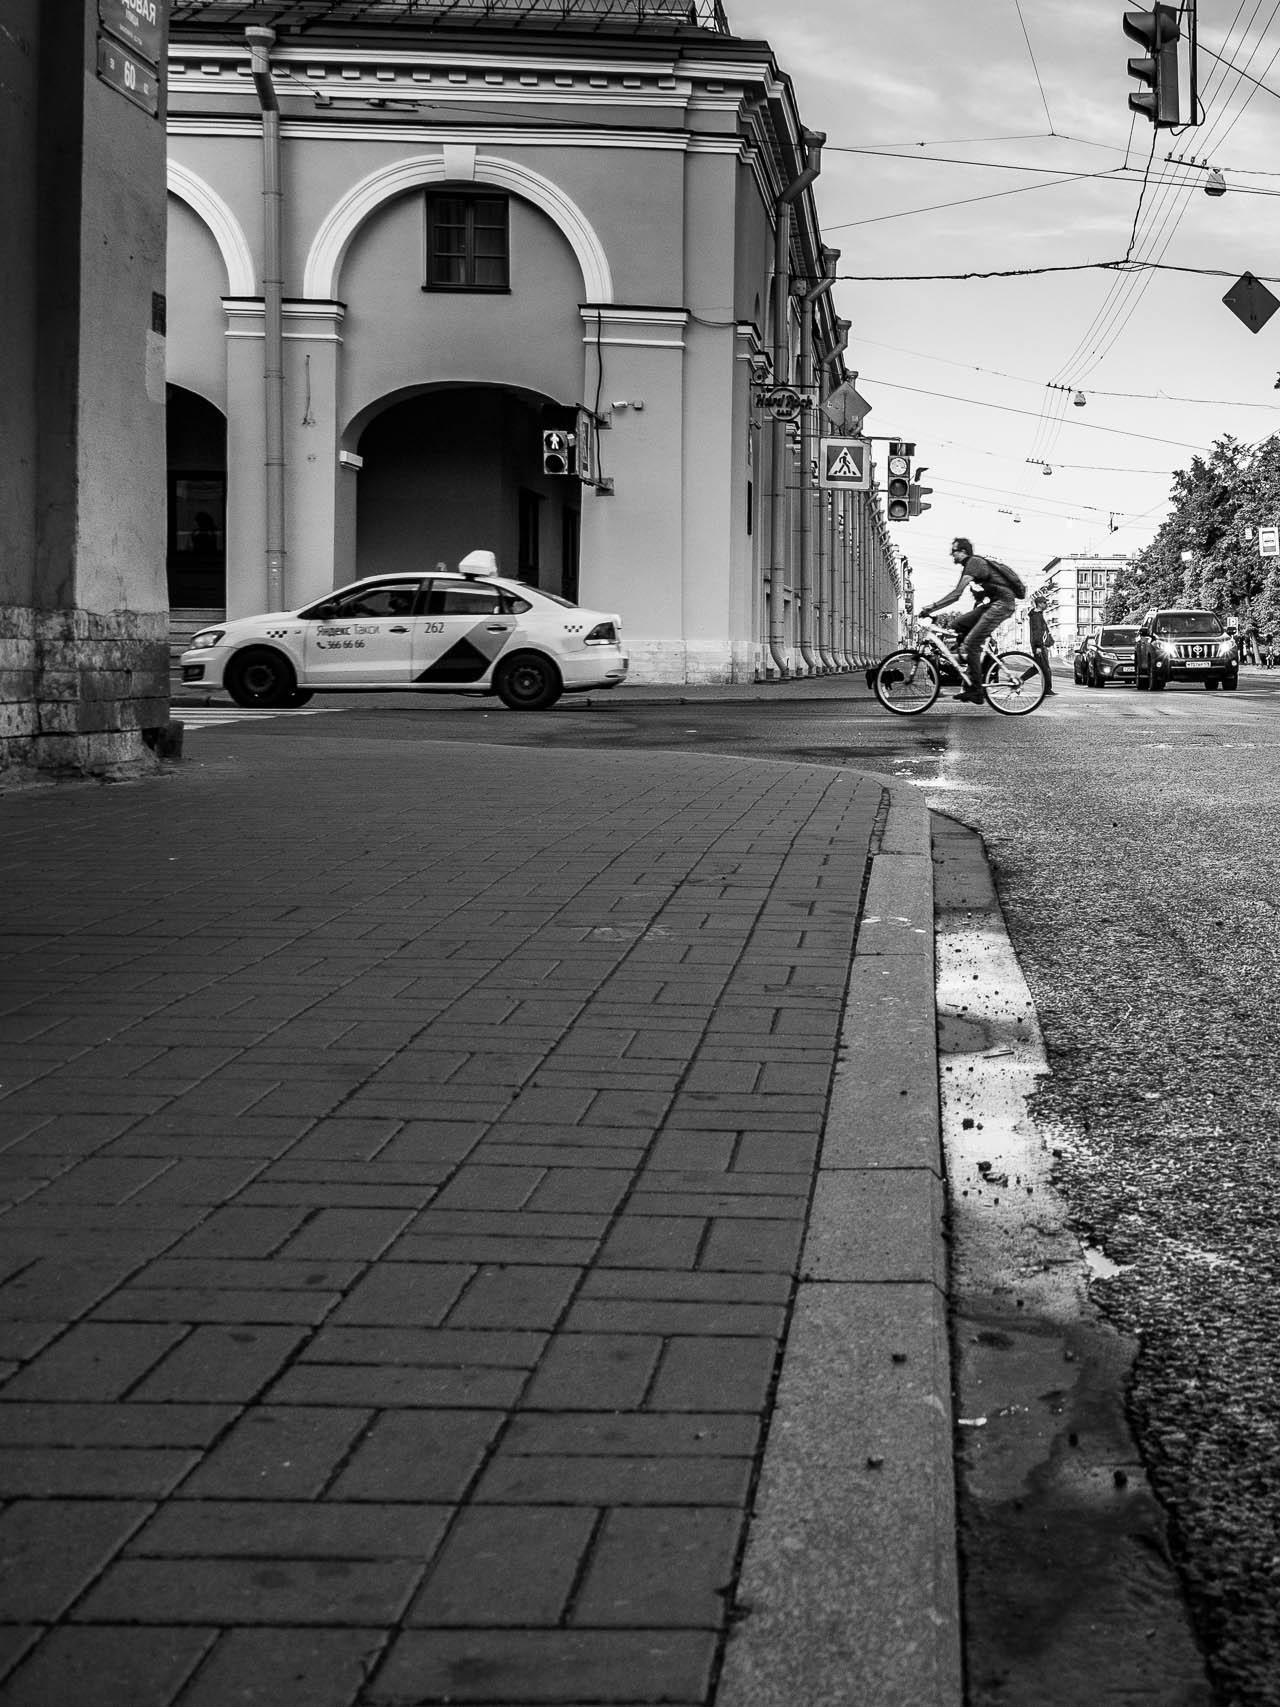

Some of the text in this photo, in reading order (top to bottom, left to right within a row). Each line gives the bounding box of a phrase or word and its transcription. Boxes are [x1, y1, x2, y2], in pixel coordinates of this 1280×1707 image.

[124, 61, 136, 90] 60
[317, 625, 351, 637] Яндекс
[424, 622, 445, 634] 262
[327, 639, 366, 650] 366 66 66
